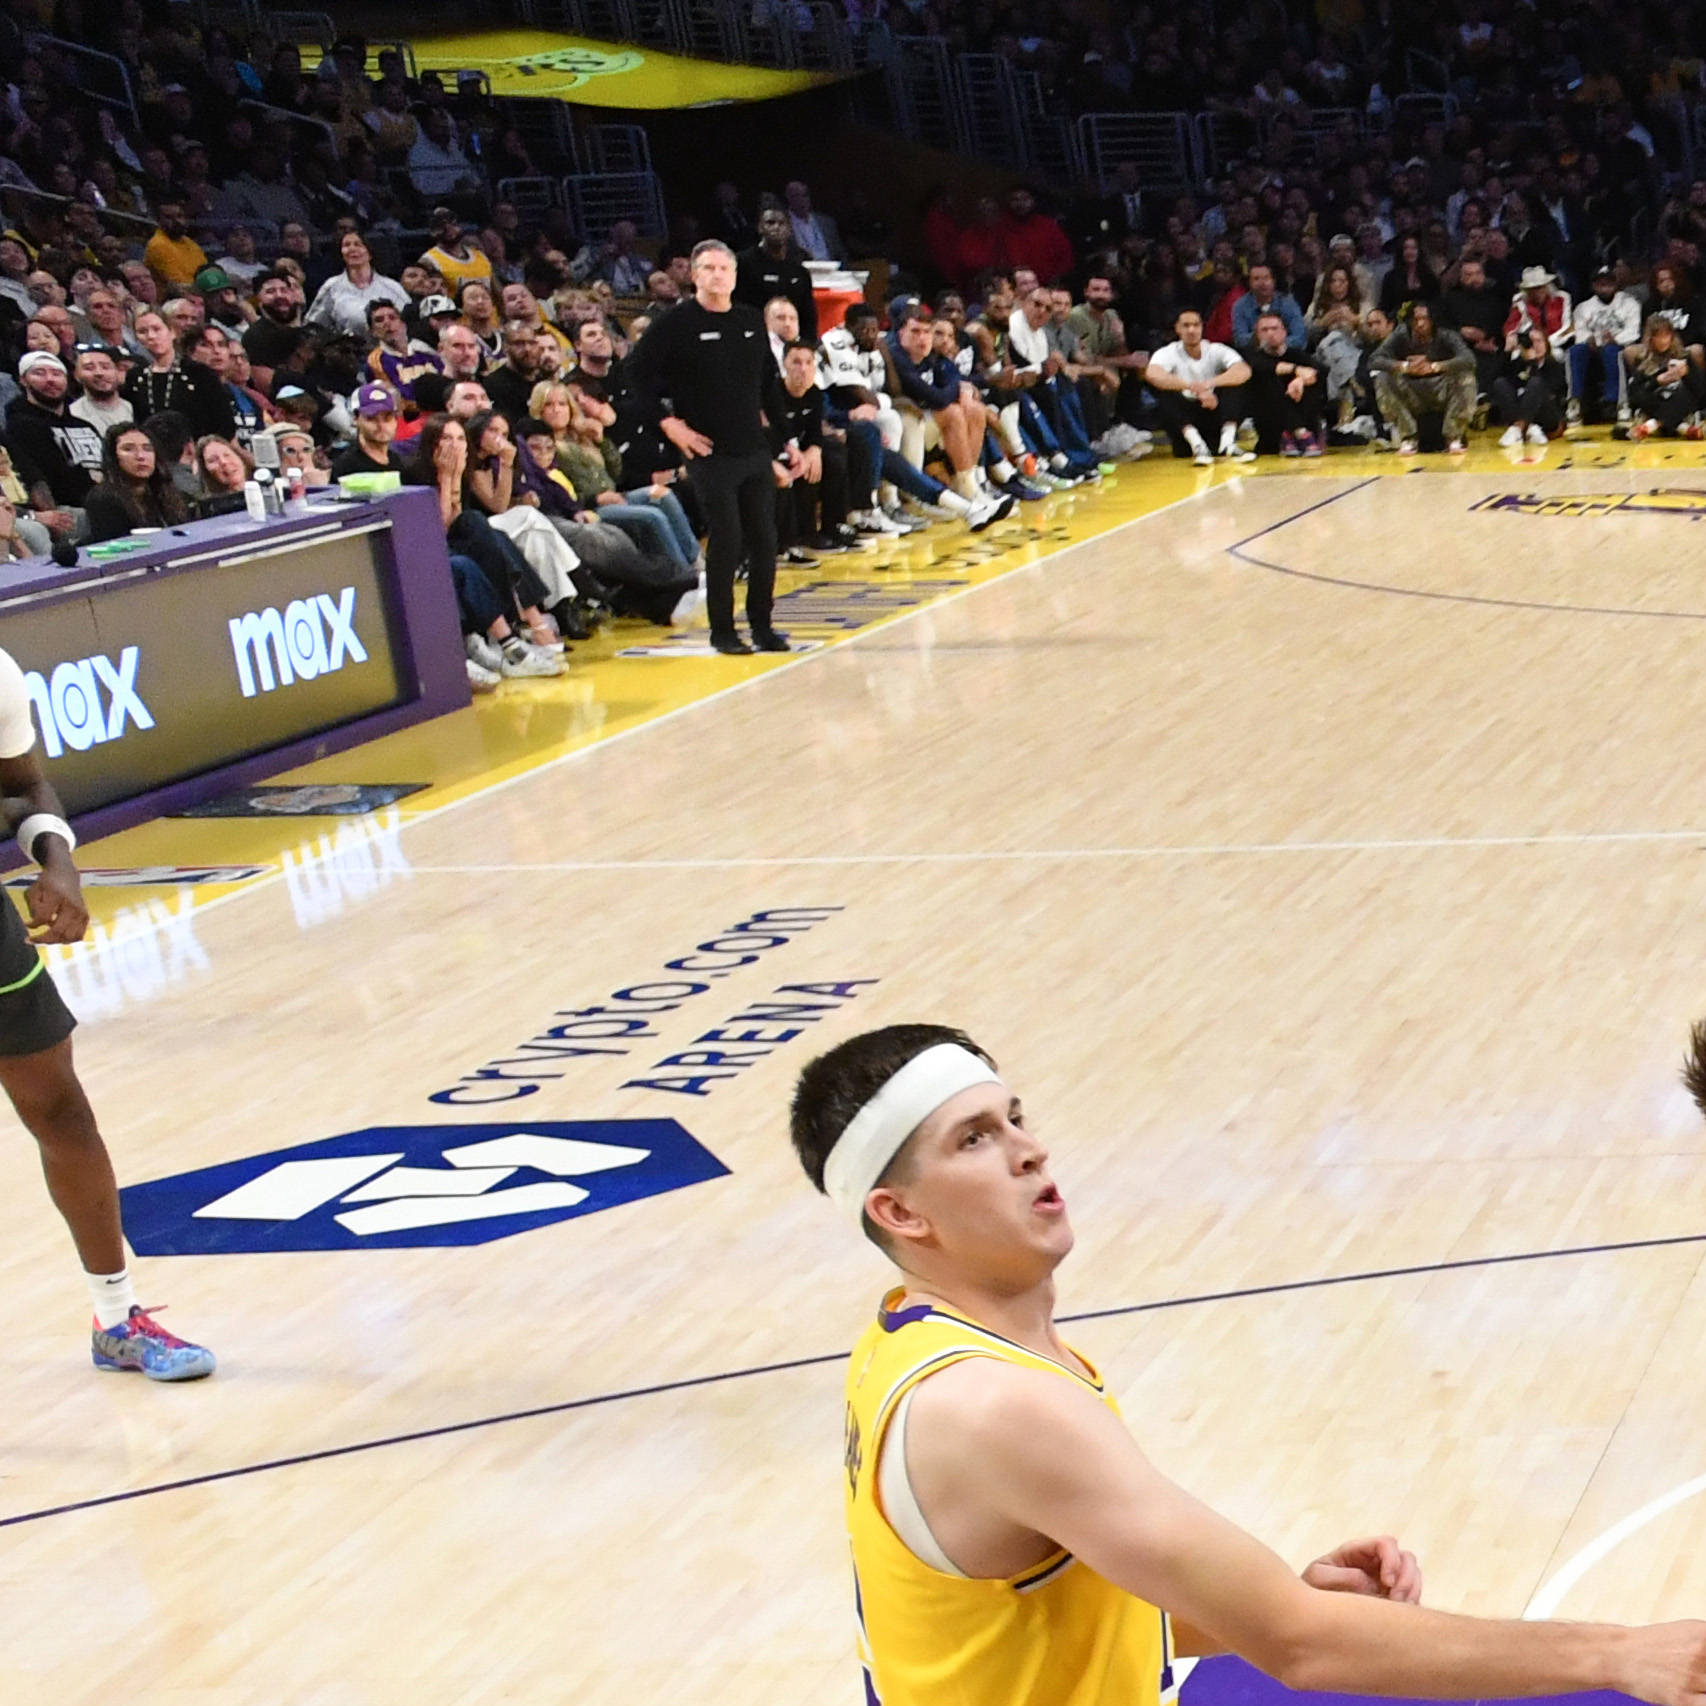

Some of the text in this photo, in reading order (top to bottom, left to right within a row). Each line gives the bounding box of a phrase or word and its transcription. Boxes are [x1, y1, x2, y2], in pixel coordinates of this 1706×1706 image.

[228, 586, 368, 699] max
[427, 906, 845, 1105] crypto.com
[616, 977, 881, 1097] ARENA
